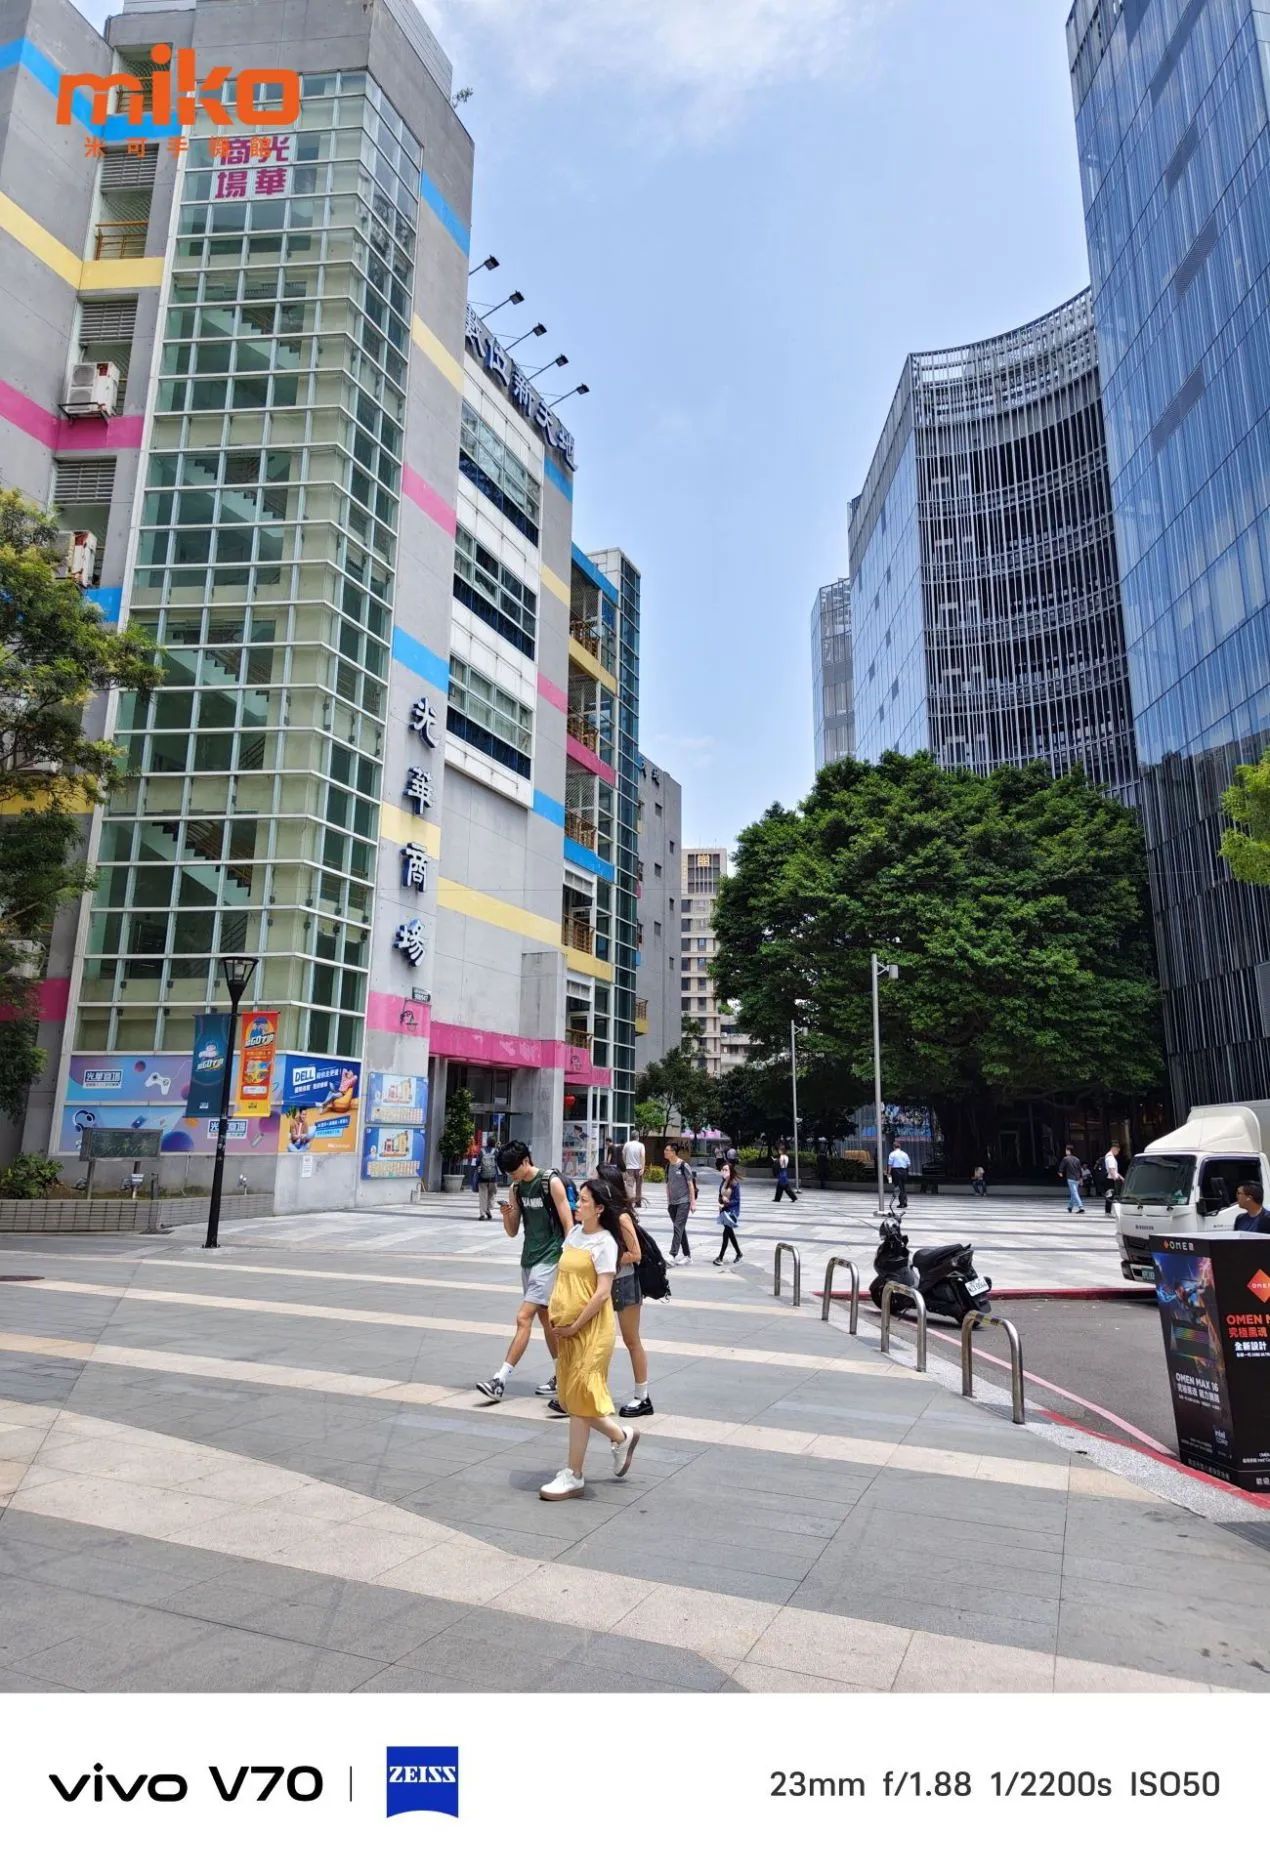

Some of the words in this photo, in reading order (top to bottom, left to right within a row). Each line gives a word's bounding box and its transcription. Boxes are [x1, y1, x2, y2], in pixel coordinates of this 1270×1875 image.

[393, 697, 439, 967] 光華商場
[295, 1069, 314, 1083] DELL
[1226, 1314, 1263, 1325] OMEN
[1175, 1372, 1195, 1385] OMEN
[1195, 1377, 1211, 1390] MAX
